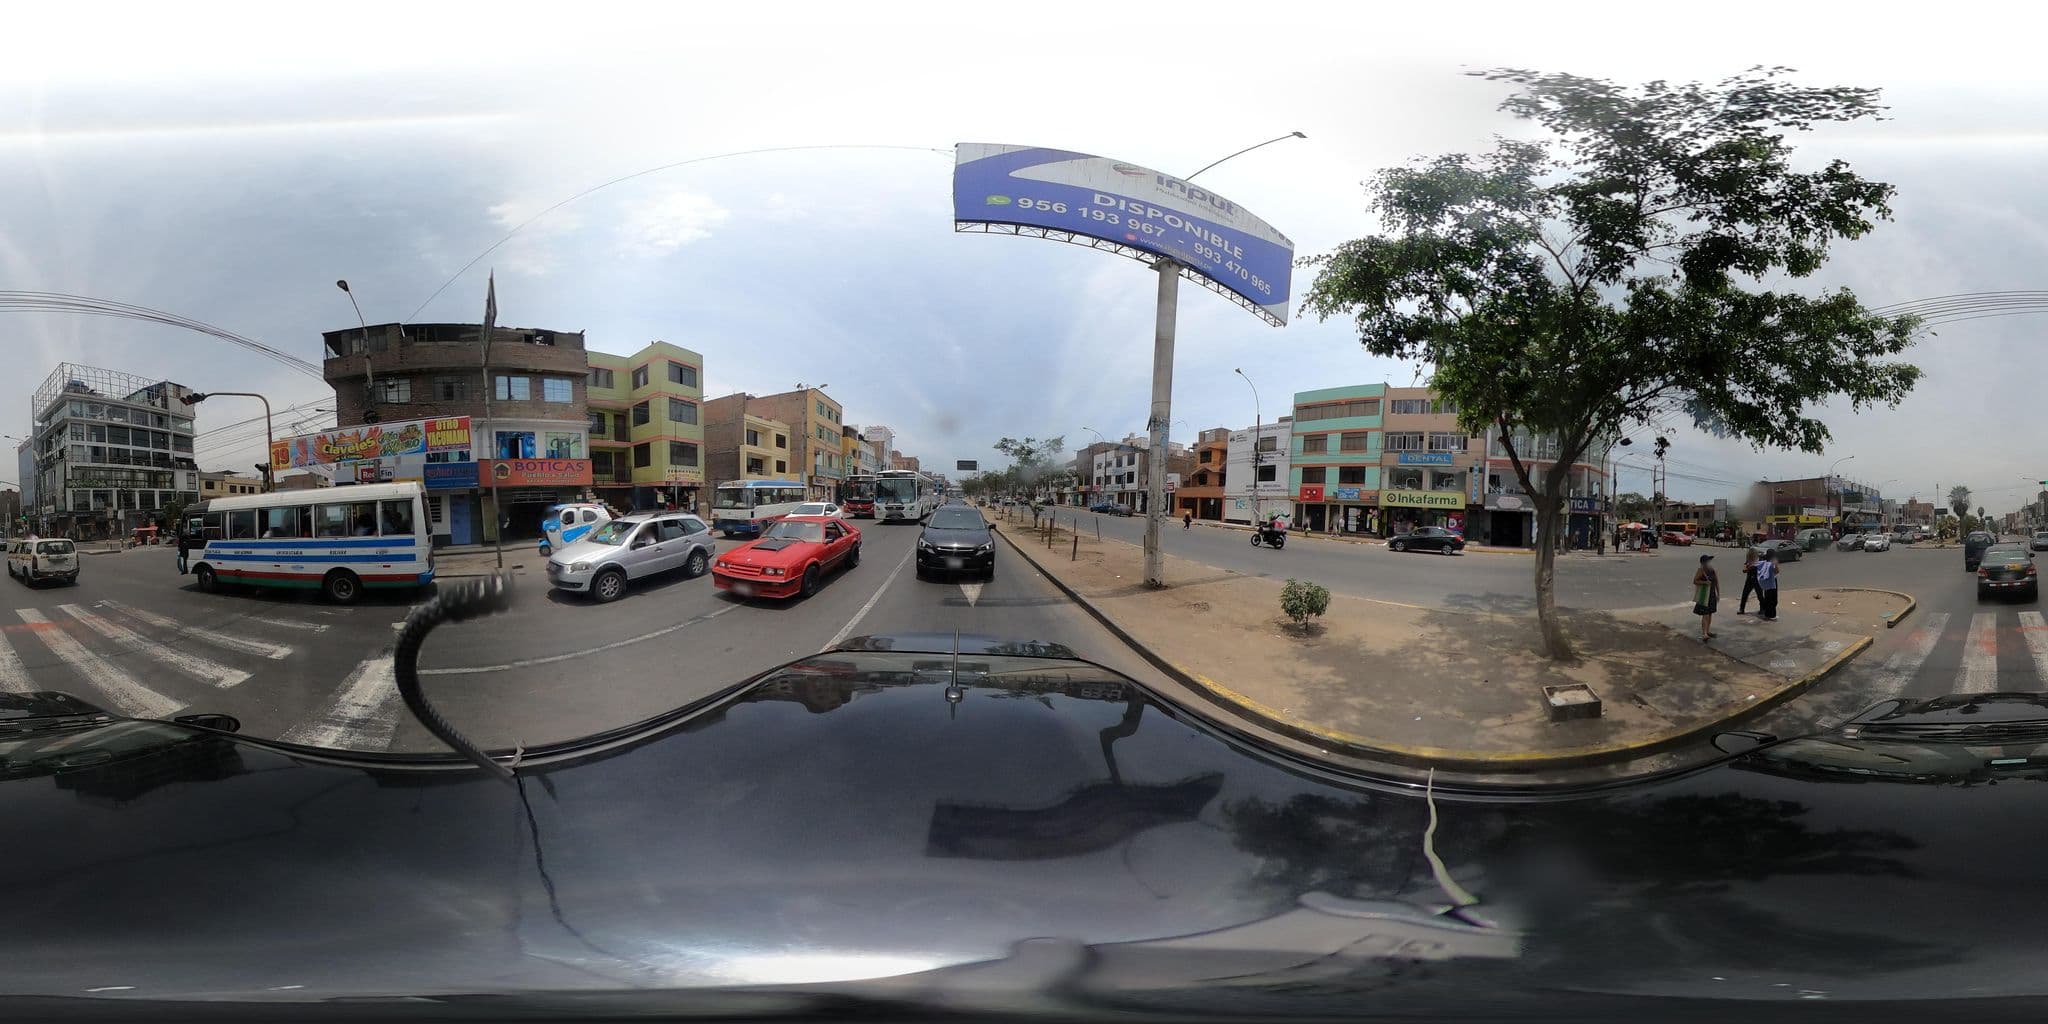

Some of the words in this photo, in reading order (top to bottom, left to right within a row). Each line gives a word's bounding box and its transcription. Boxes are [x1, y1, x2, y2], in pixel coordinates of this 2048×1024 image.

[1157, 175, 1234, 216] input
[1093, 193, 1243, 260] DISPONIBLE
[1018, 197, 1068, 214] 956
[1078, 207, 1120, 225] 193
[1127, 218, 1166, 238] 967
[1194, 242, 1222, 264] 993
[1225, 260, 1249, 280] 470
[1251, 275, 1271, 295] 965
[435, 418, 459, 430] OTRO
[321, 437, 377, 455] Claveles
[272, 447, 290, 466] 19
[1407, 454, 1449, 463] DENTAL
[514, 461, 585, 471] BOTICAS
[1397, 493, 1457, 505] Inkafarma
